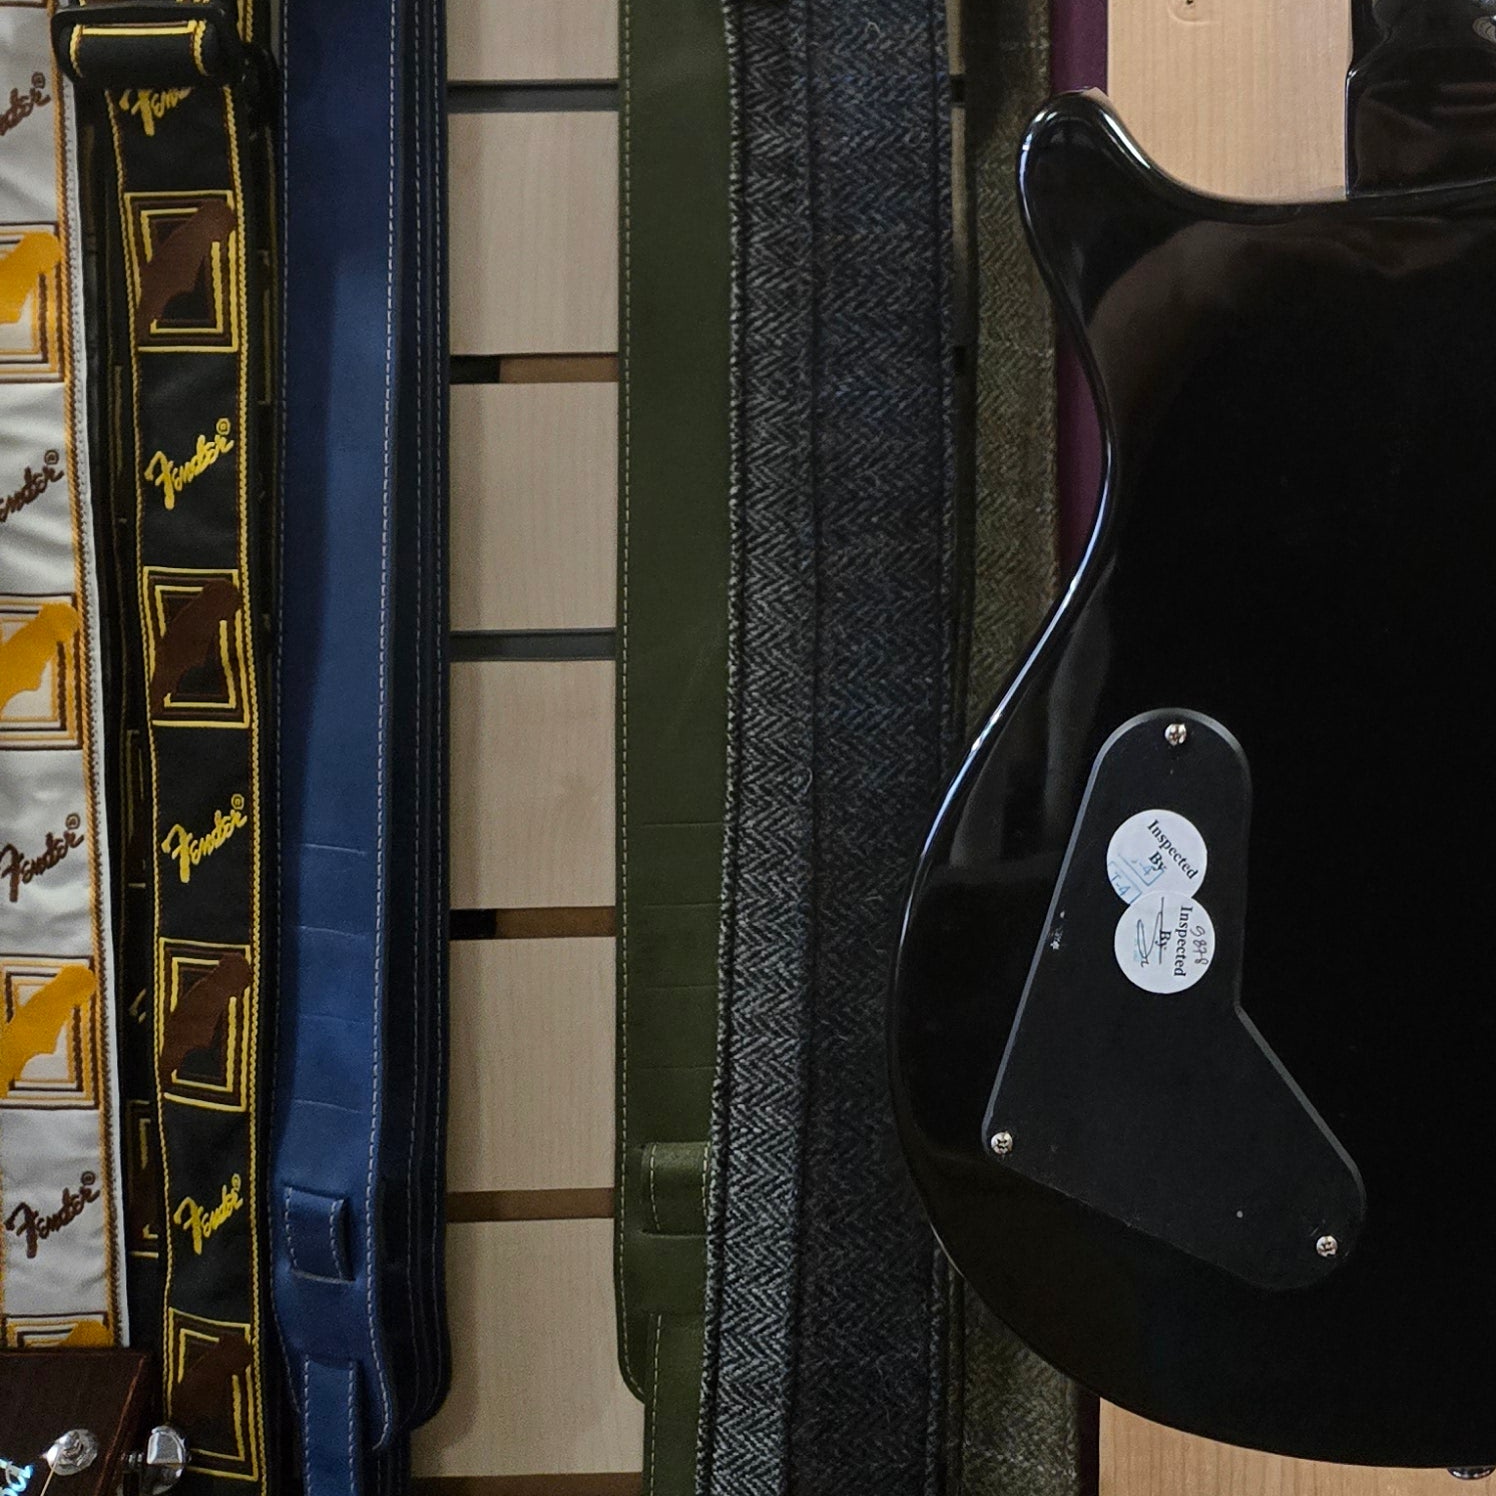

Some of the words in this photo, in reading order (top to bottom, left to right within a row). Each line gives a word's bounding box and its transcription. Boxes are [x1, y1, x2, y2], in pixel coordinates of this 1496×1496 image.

[144, 434, 235, 511] Fender
[0, 831, 85, 903] Fender
[161, 809, 248, 884] Fender
[1147, 819, 1199, 880] Inspected
[1149, 851, 1168, 872] By
[1155, 930, 1173, 951] By
[1173, 906, 1194, 977] Inspected
[4, 1185, 101, 1259] Fender
[173, 1184, 244, 1255] Fender
